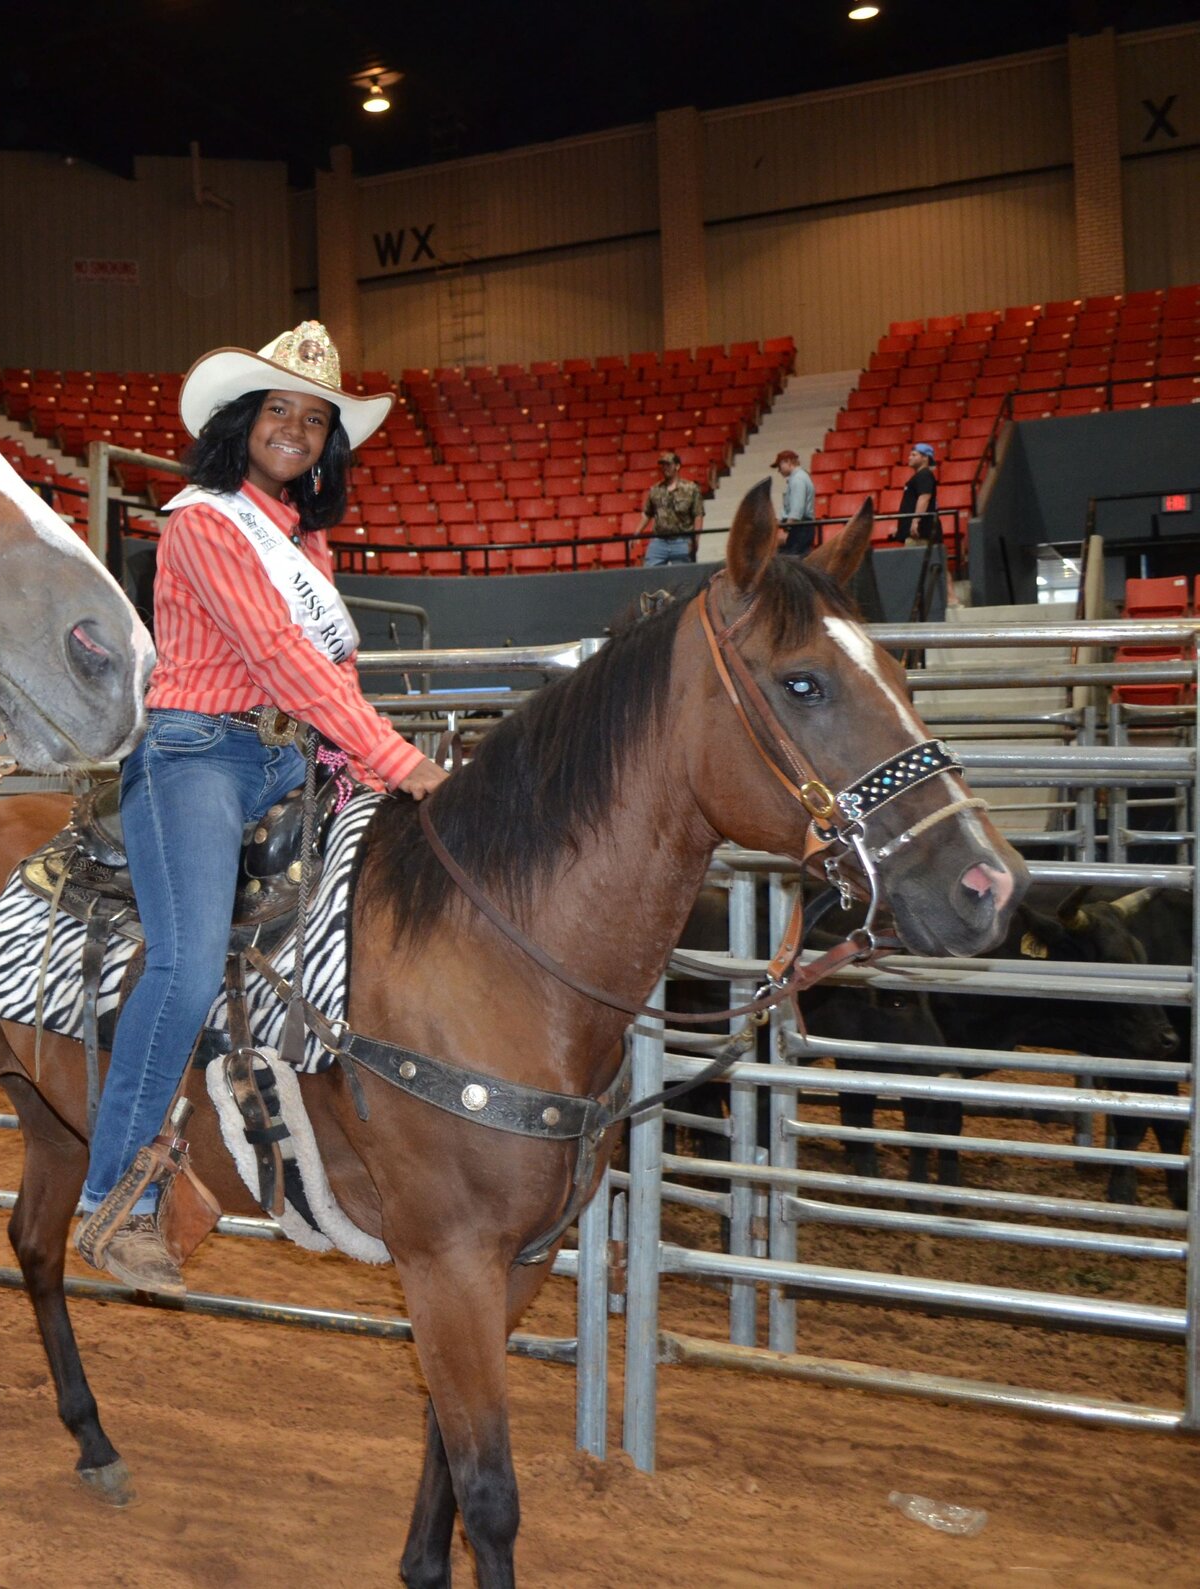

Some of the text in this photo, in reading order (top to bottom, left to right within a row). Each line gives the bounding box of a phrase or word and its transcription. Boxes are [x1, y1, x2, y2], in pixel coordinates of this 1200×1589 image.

[1141, 94, 1179, 142] X
[372, 223, 436, 268] WX
[289, 571, 326, 621] MISS
